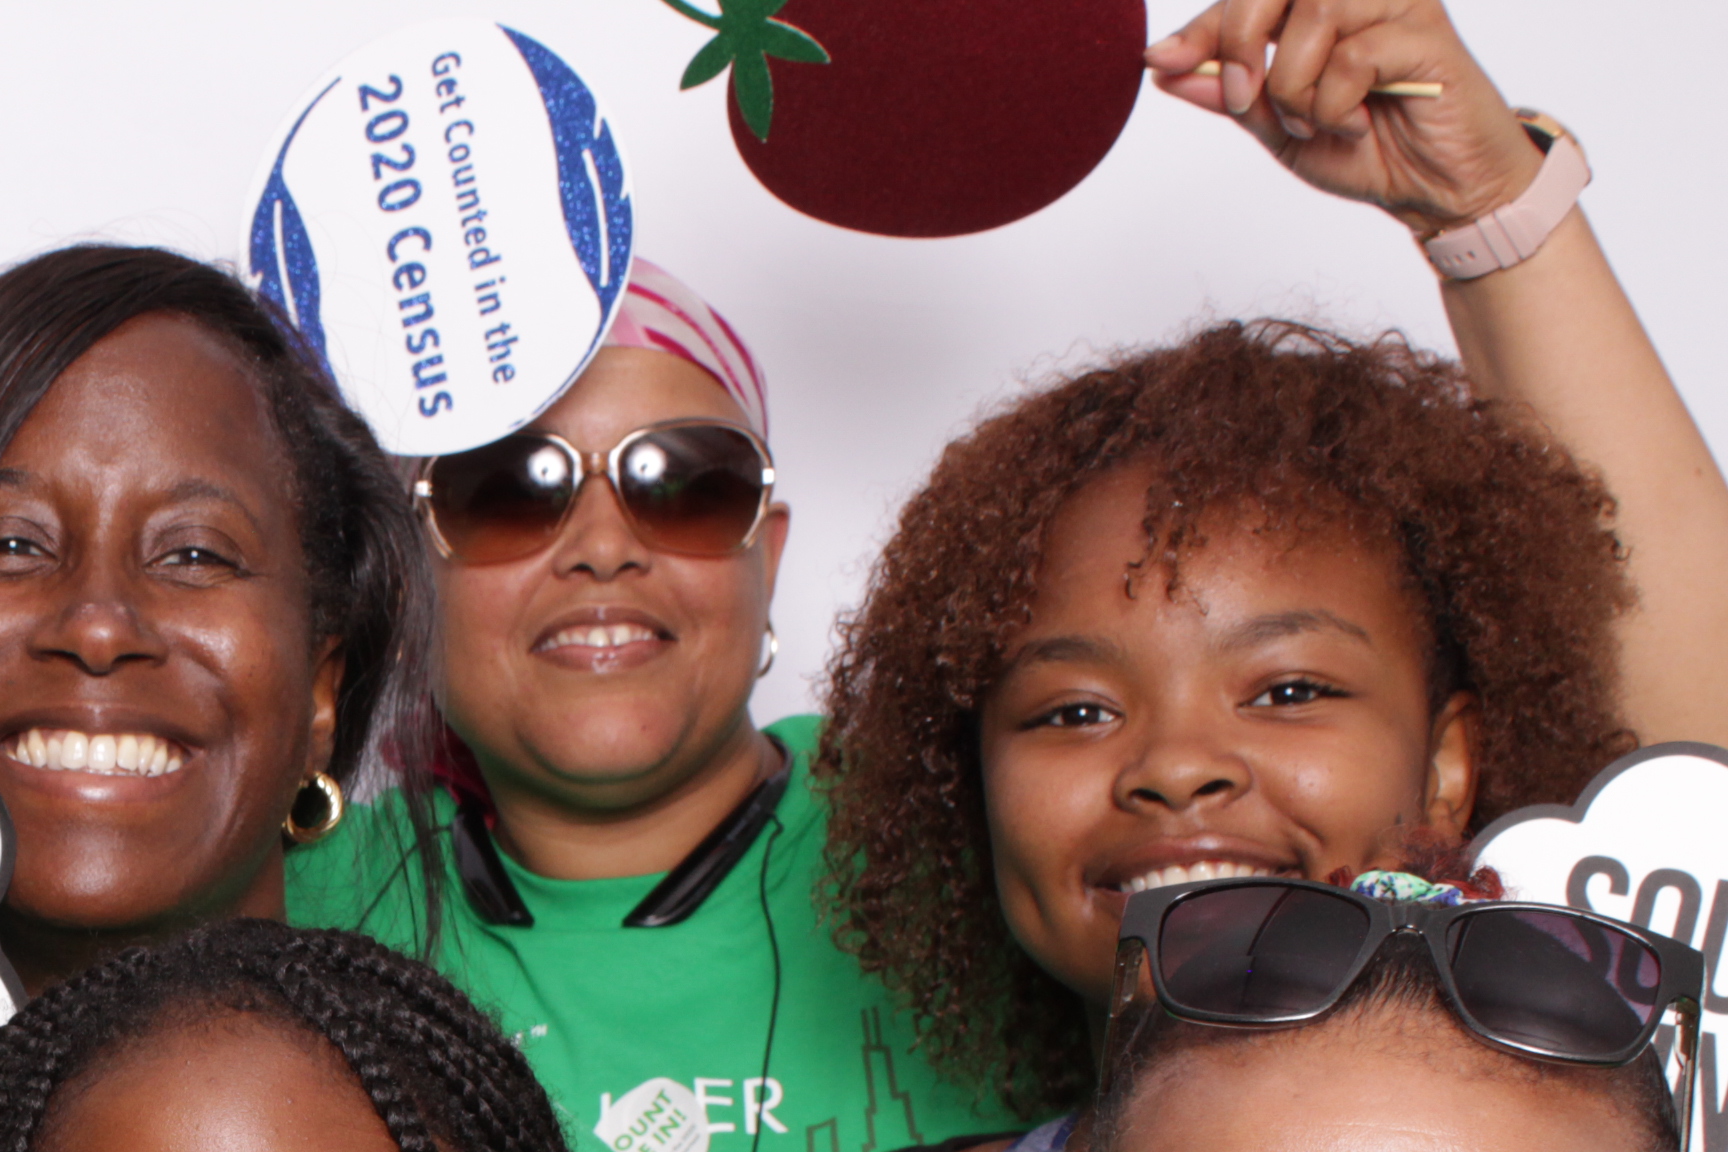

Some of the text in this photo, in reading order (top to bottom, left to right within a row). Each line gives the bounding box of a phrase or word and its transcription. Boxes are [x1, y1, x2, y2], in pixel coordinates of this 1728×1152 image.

[358, 74, 453, 418] 2020 Census
[431, 50, 520, 385] Get Counted in the
[613, 1087, 673, 1152] OUNT
[653, 1107, 687, 1145] IN!
